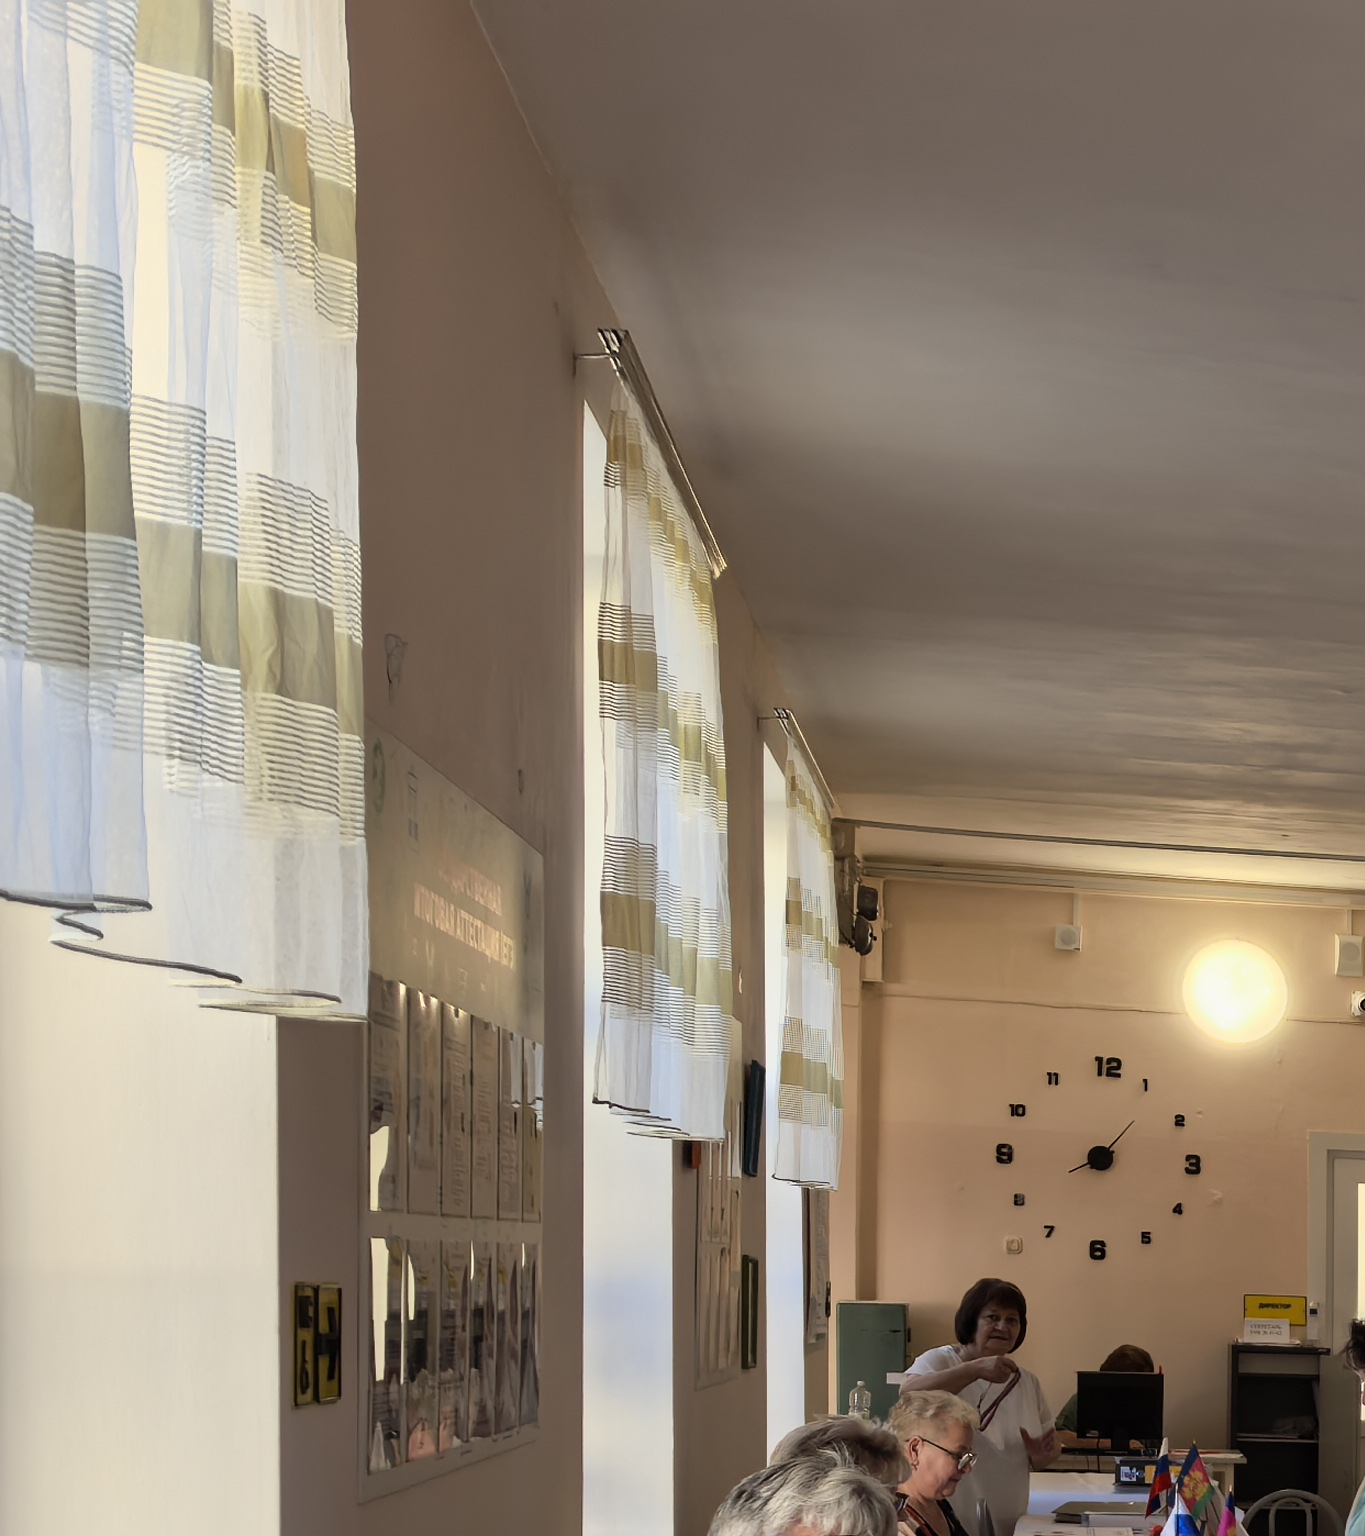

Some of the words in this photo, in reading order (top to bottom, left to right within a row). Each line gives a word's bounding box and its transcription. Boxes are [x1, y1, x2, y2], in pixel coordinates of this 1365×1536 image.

[1094, 1056, 1122, 1079] 12
[1047, 1072, 1060, 1086] 11
[1142, 1079, 1148, 1092] 1
[1009, 1103, 1026, 1117] 10
[1174, 1114, 1185, 1127] 2
[995, 1143, 1014, 1164] 9
[1184, 1154, 1201, 1175] 3
[1013, 1193, 1025, 1206] 8
[1172, 1202, 1183, 1215] 4
[1043, 1225, 1055, 1238] 7
[1140, 1231, 1152, 1245] 5
[1089, 1239, 1107, 1260] 6
